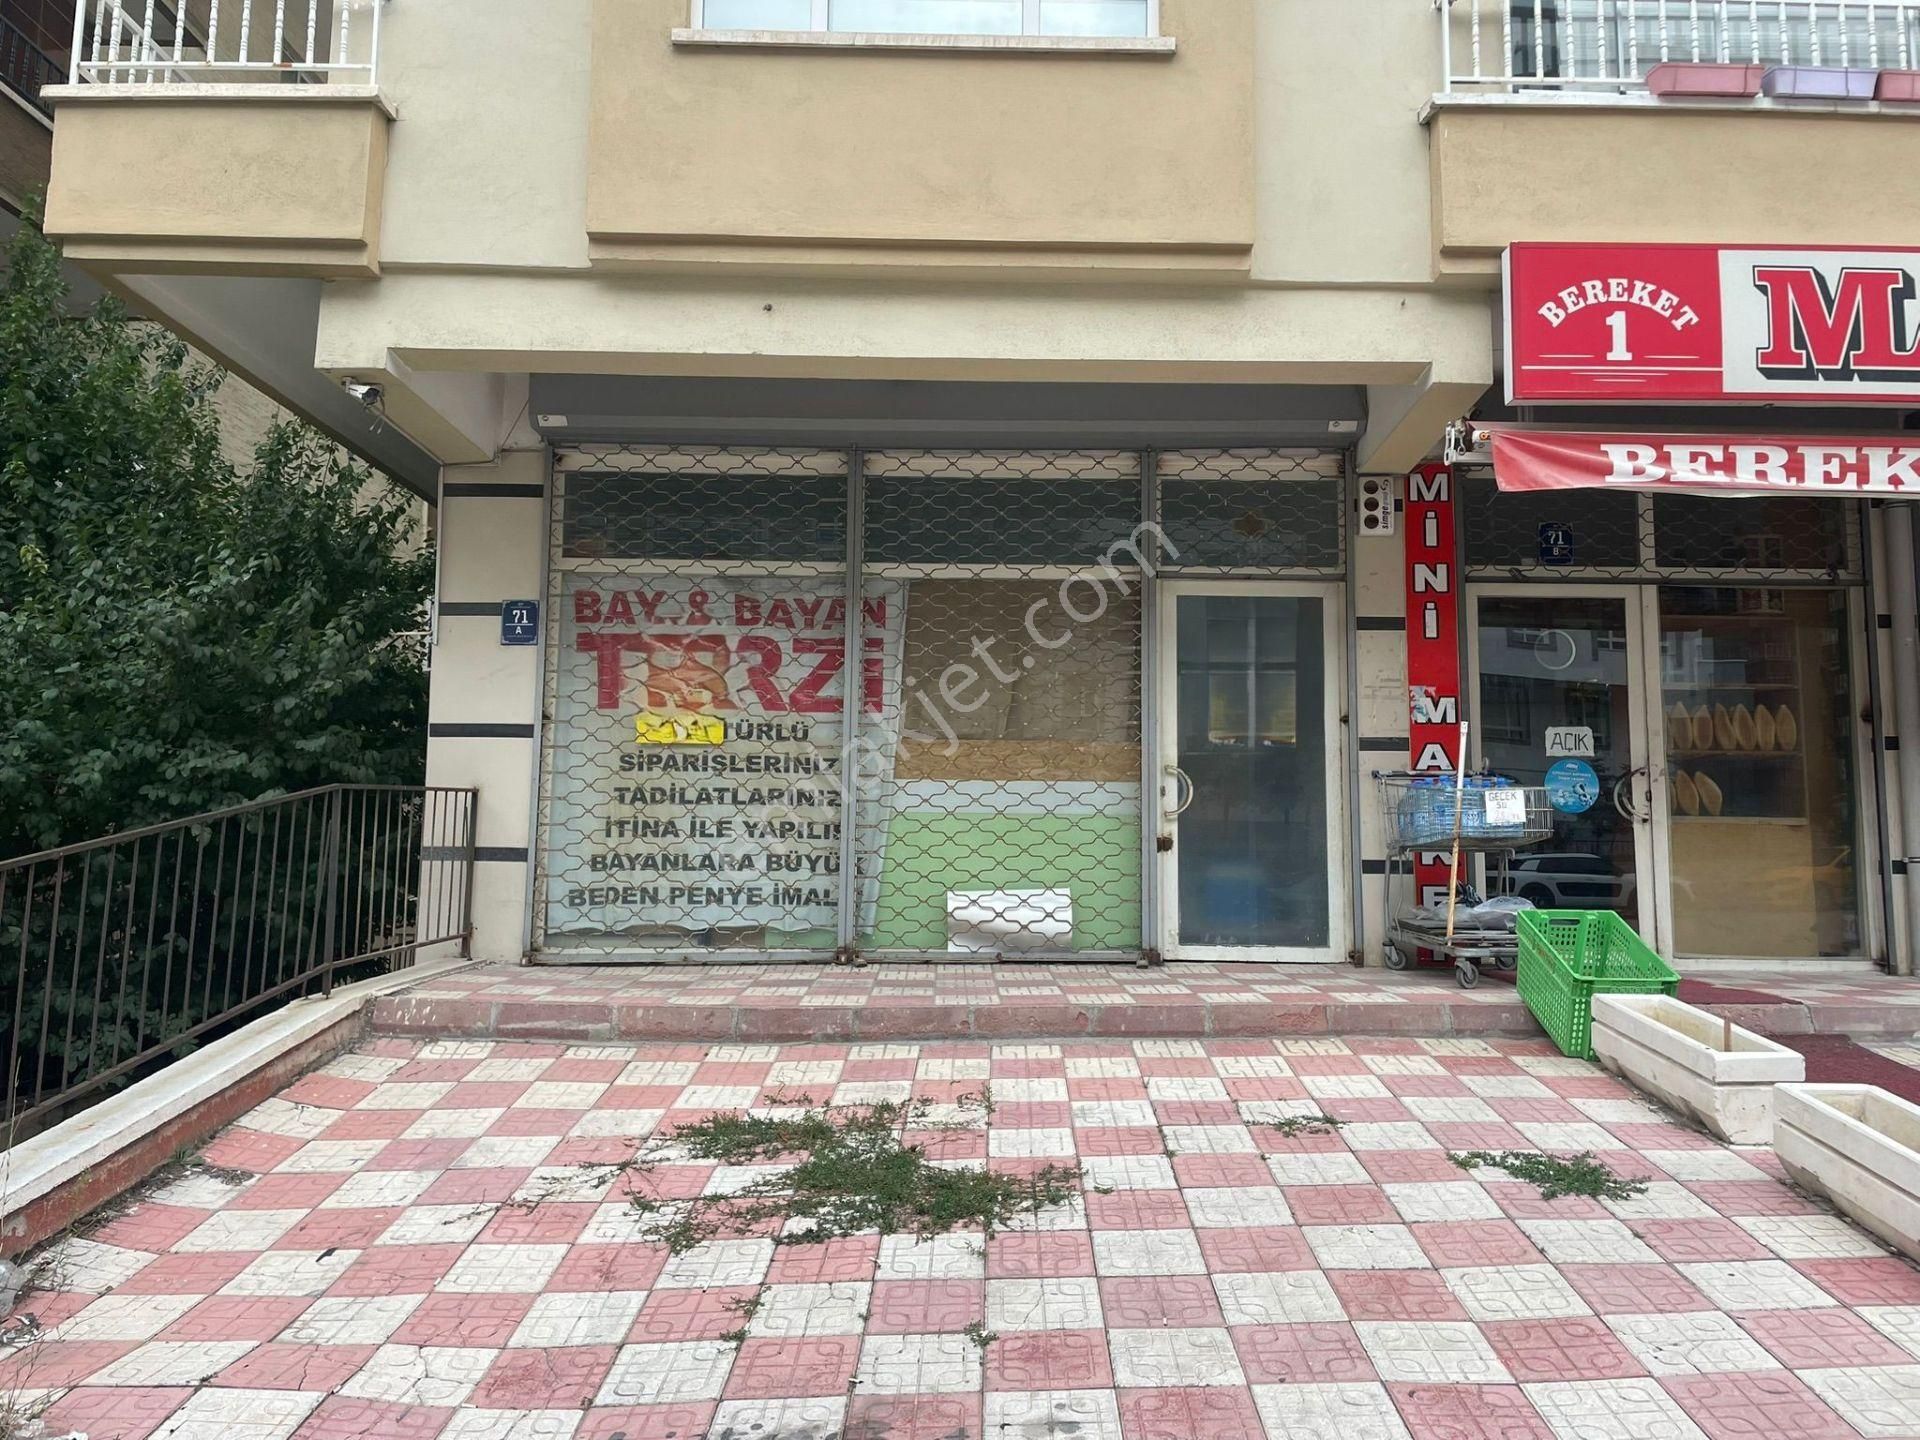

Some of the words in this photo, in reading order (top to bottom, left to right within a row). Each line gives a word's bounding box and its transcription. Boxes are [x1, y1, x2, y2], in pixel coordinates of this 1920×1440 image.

[1538, 278, 1699, 331] BEREKET
[1753, 265, 1920, 382] M
[1606, 311, 1632, 360] 1
[1547, 530, 1564, 545] 71
[512, 609, 529, 624] 71
[575, 589, 664, 626] BAY
[734, 593, 887, 630] BAYAN
[515, 625, 523, 635] A
[1550, 732, 1589, 753] AÇIK
[605, 815, 680, 839] İTİNA
[690, 815, 733, 838] İLE
[590, 852, 756, 873] BAYANLARA
[568, 887, 661, 907] BEDEN
[669, 886, 764, 906] PENYE
